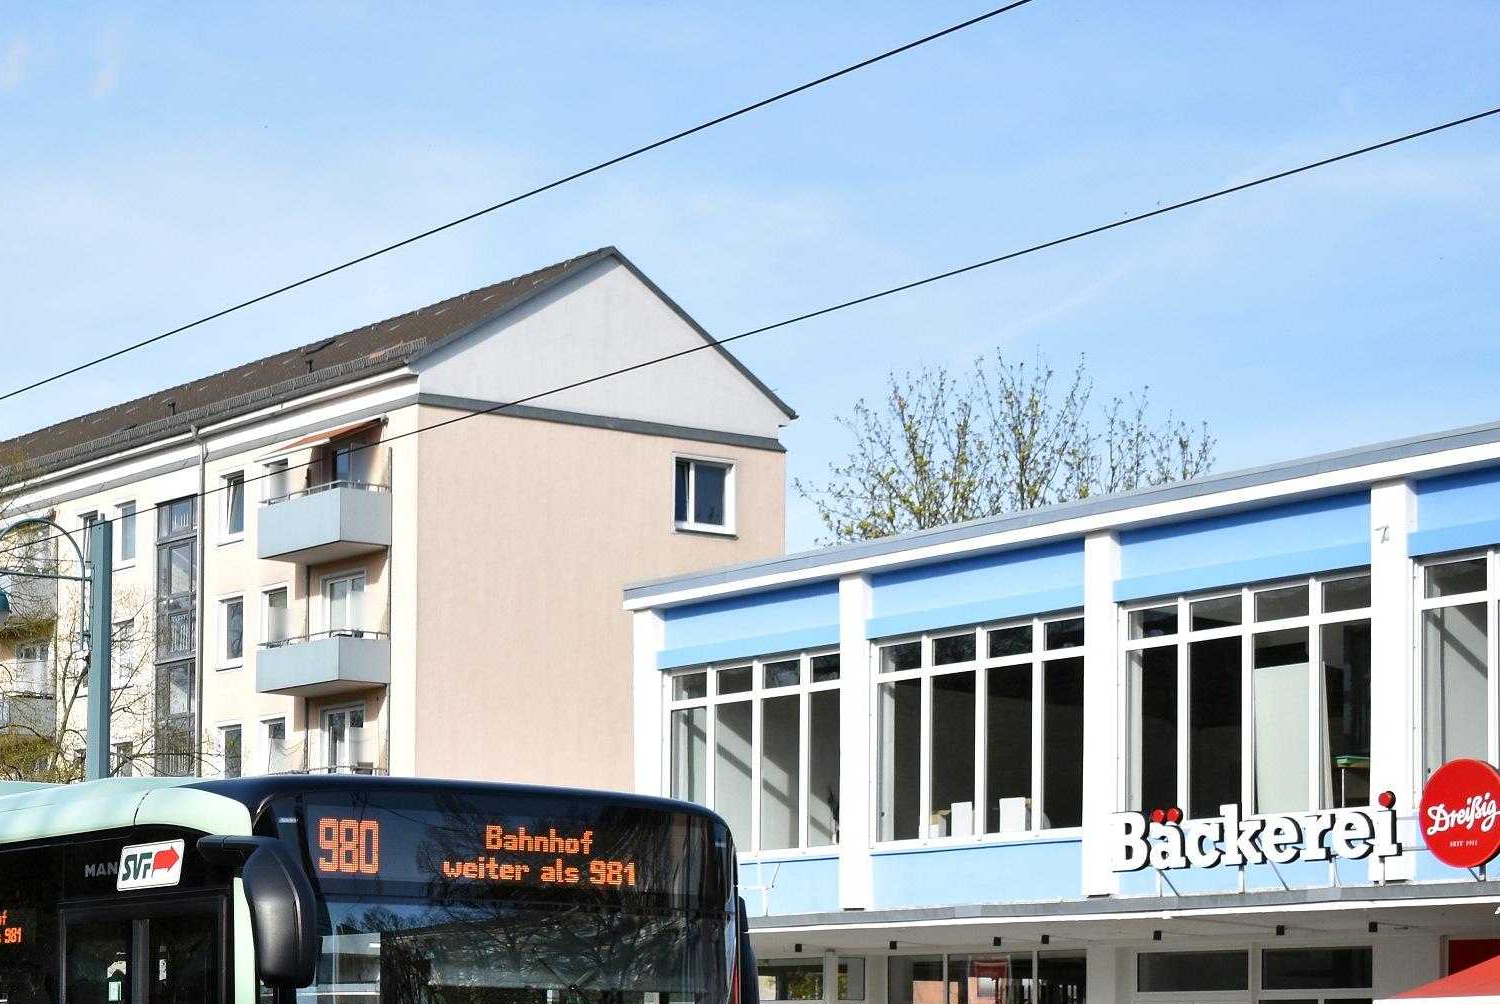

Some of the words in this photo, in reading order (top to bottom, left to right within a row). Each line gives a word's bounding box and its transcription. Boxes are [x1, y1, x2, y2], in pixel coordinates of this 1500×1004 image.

[1427, 792, 1500, 836] Dreißig
[319, 817, 380, 874] 980
[486, 825, 593, 855] Bahnhof
[1112, 789, 1403, 872] Bäckerei
[84, 861, 118, 878] MAN
[122, 852, 153, 881] SVF
[443, 856, 530, 881] weiter
[540, 858, 580, 883] als
[590, 860, 636, 886] 981
[4, 927, 22, 943] 981
